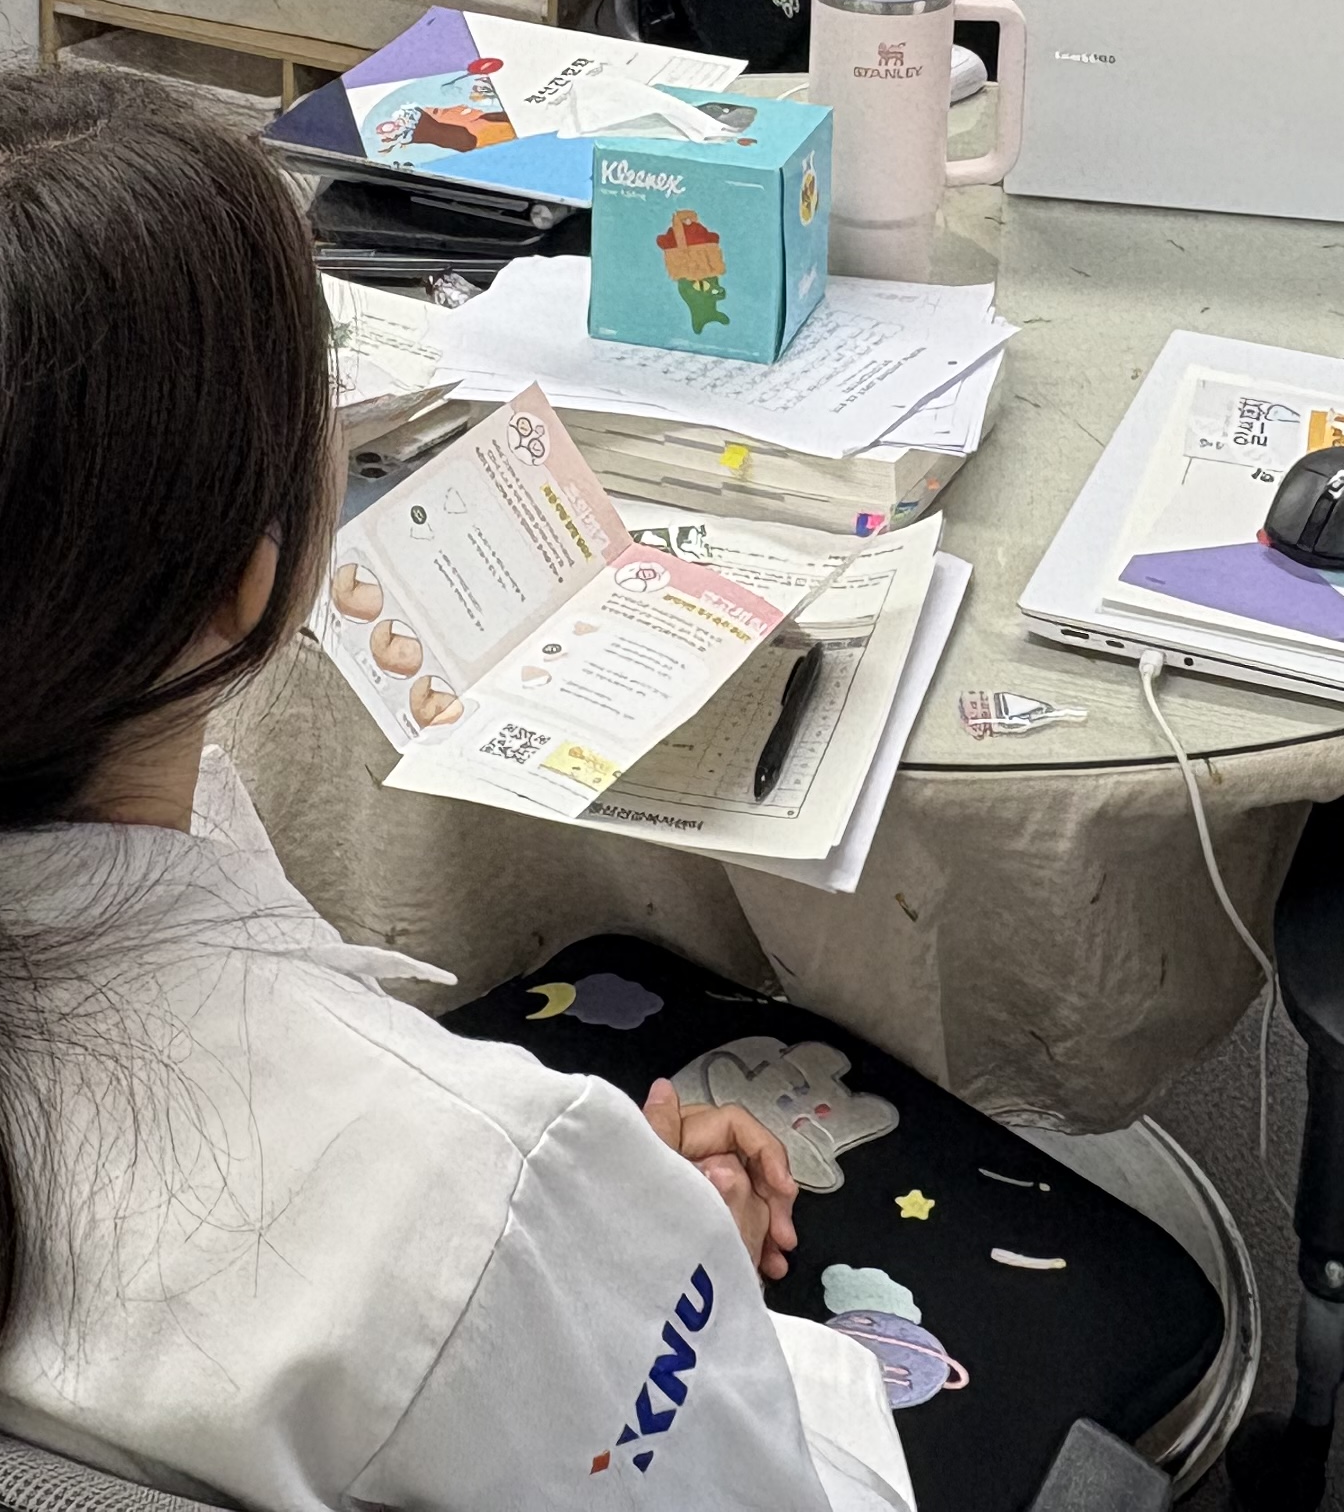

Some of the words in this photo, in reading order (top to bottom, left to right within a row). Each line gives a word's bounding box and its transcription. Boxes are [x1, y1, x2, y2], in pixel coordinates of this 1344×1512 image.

[853, 65, 924, 80] STANLEY
[601, 158, 687, 199] Kleenex
[614, 1262, 715, 1474] KNU
